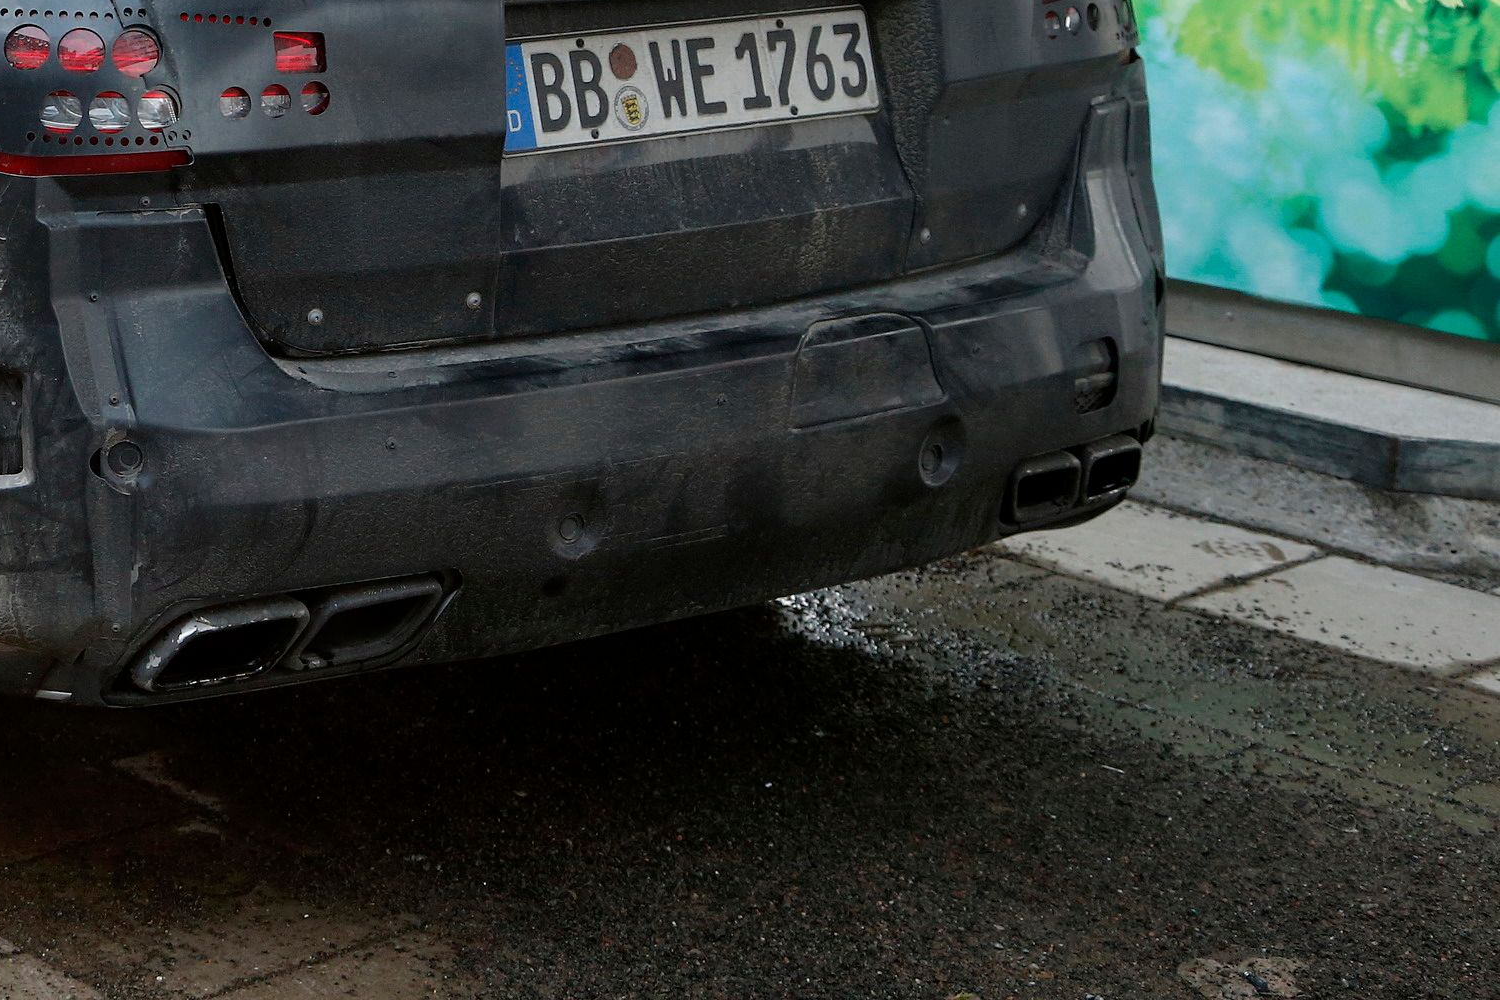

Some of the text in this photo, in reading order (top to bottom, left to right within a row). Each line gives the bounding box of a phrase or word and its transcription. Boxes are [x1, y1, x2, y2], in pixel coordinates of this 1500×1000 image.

[507, 109, 524, 134] D
[530, 51, 610, 133] BB
[648, 36, 728, 119] WE
[734, 22, 870, 111] 1763
